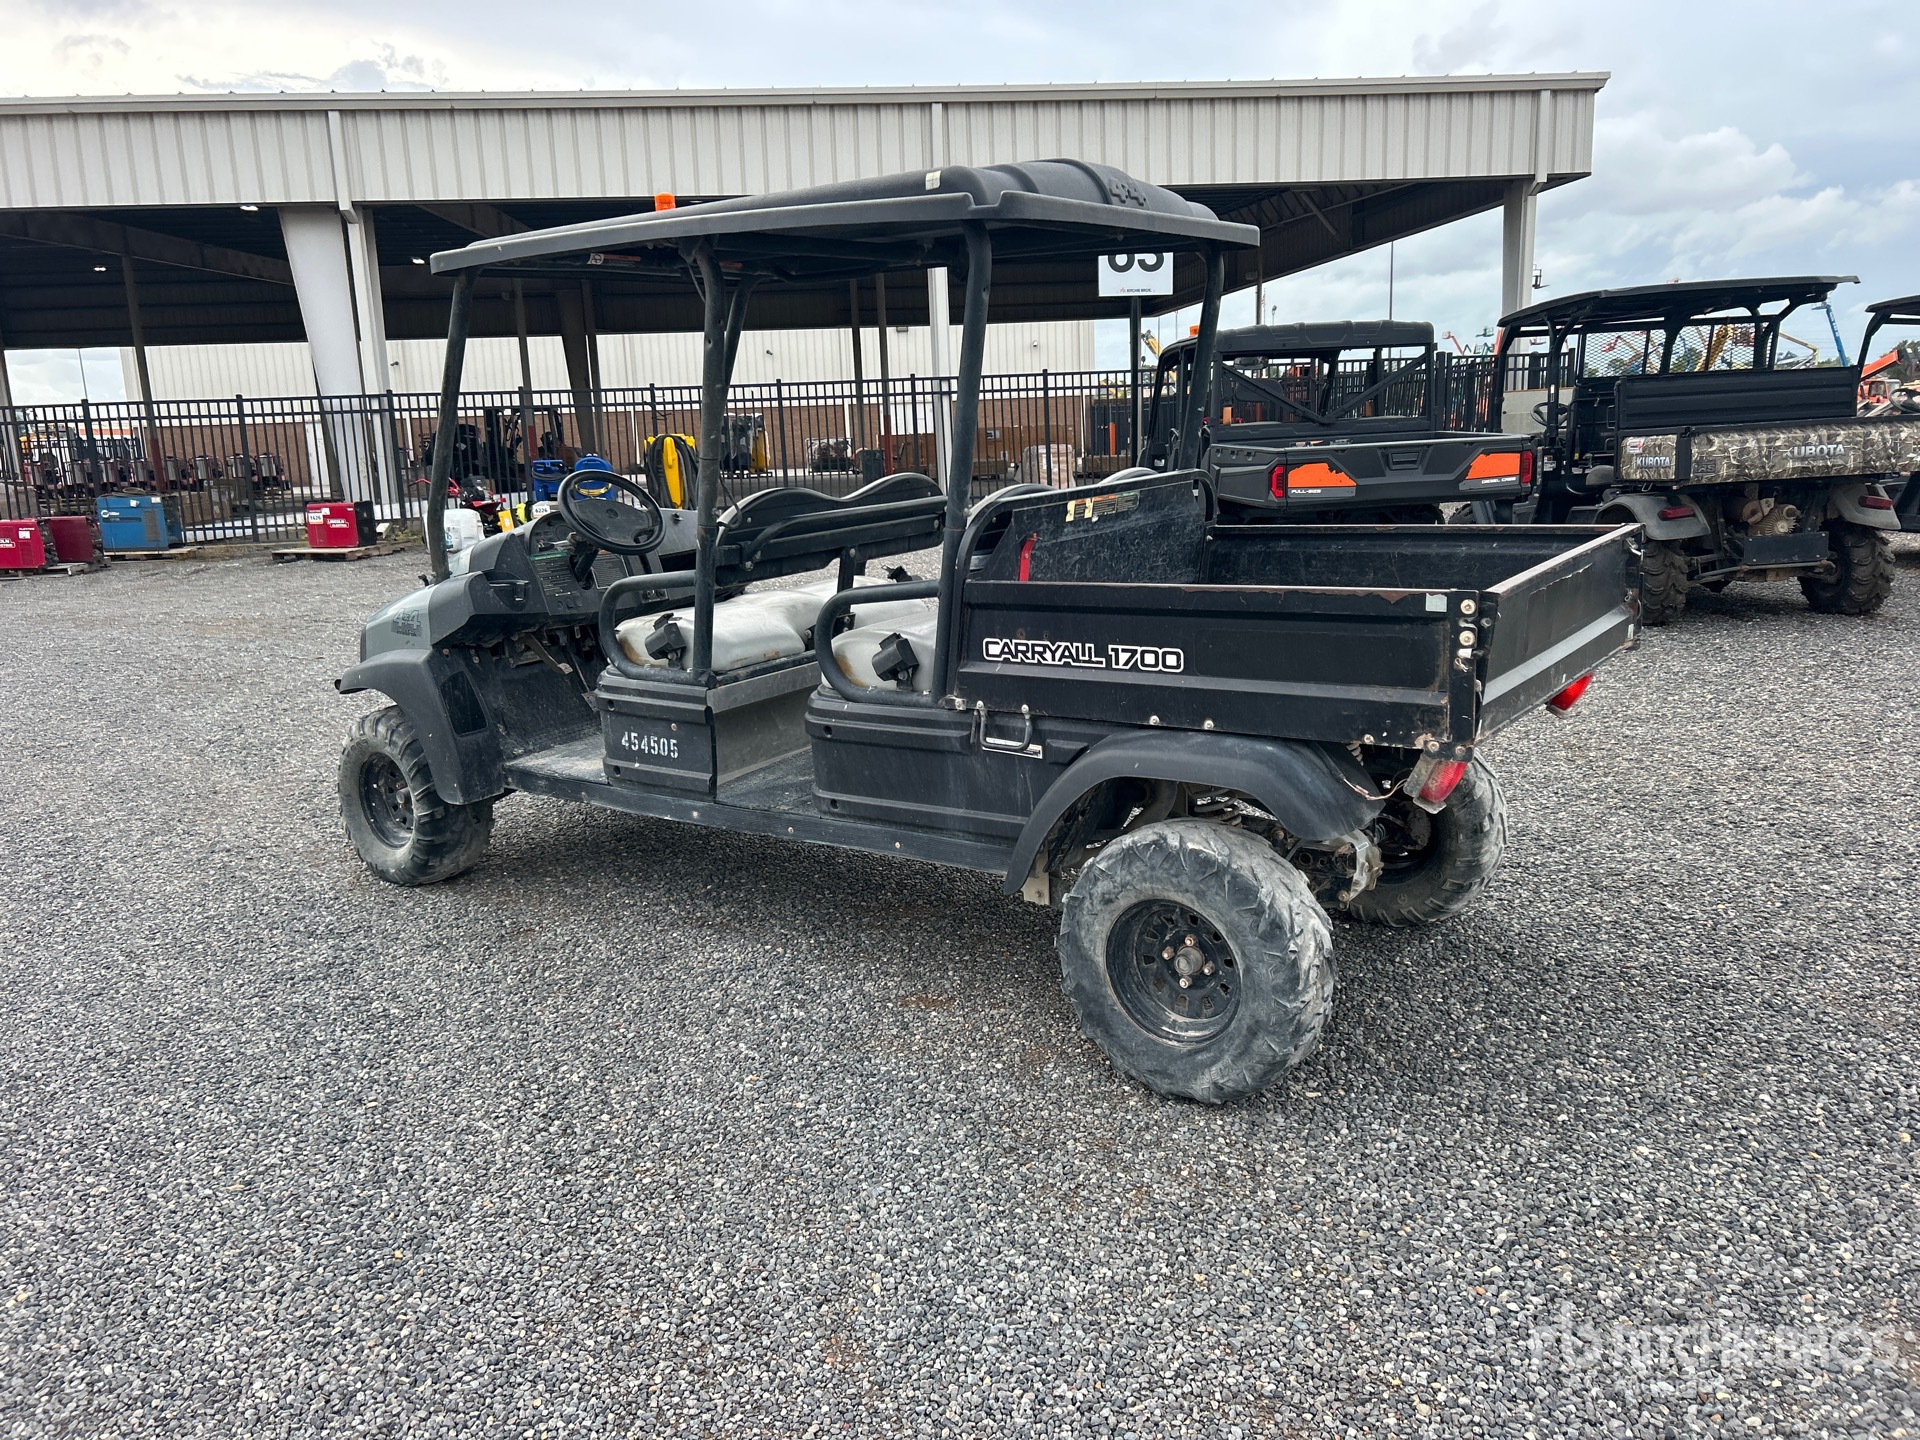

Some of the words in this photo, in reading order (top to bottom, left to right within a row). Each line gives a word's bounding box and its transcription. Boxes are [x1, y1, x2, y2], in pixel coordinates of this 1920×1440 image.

[1636, 456, 1671, 468] KUBOTA
[393, 608, 422, 629] 4x4
[983, 637, 1106, 668] CARRYALL
[1108, 644, 1185, 673] 1700
[621, 731, 679, 759] 454505
